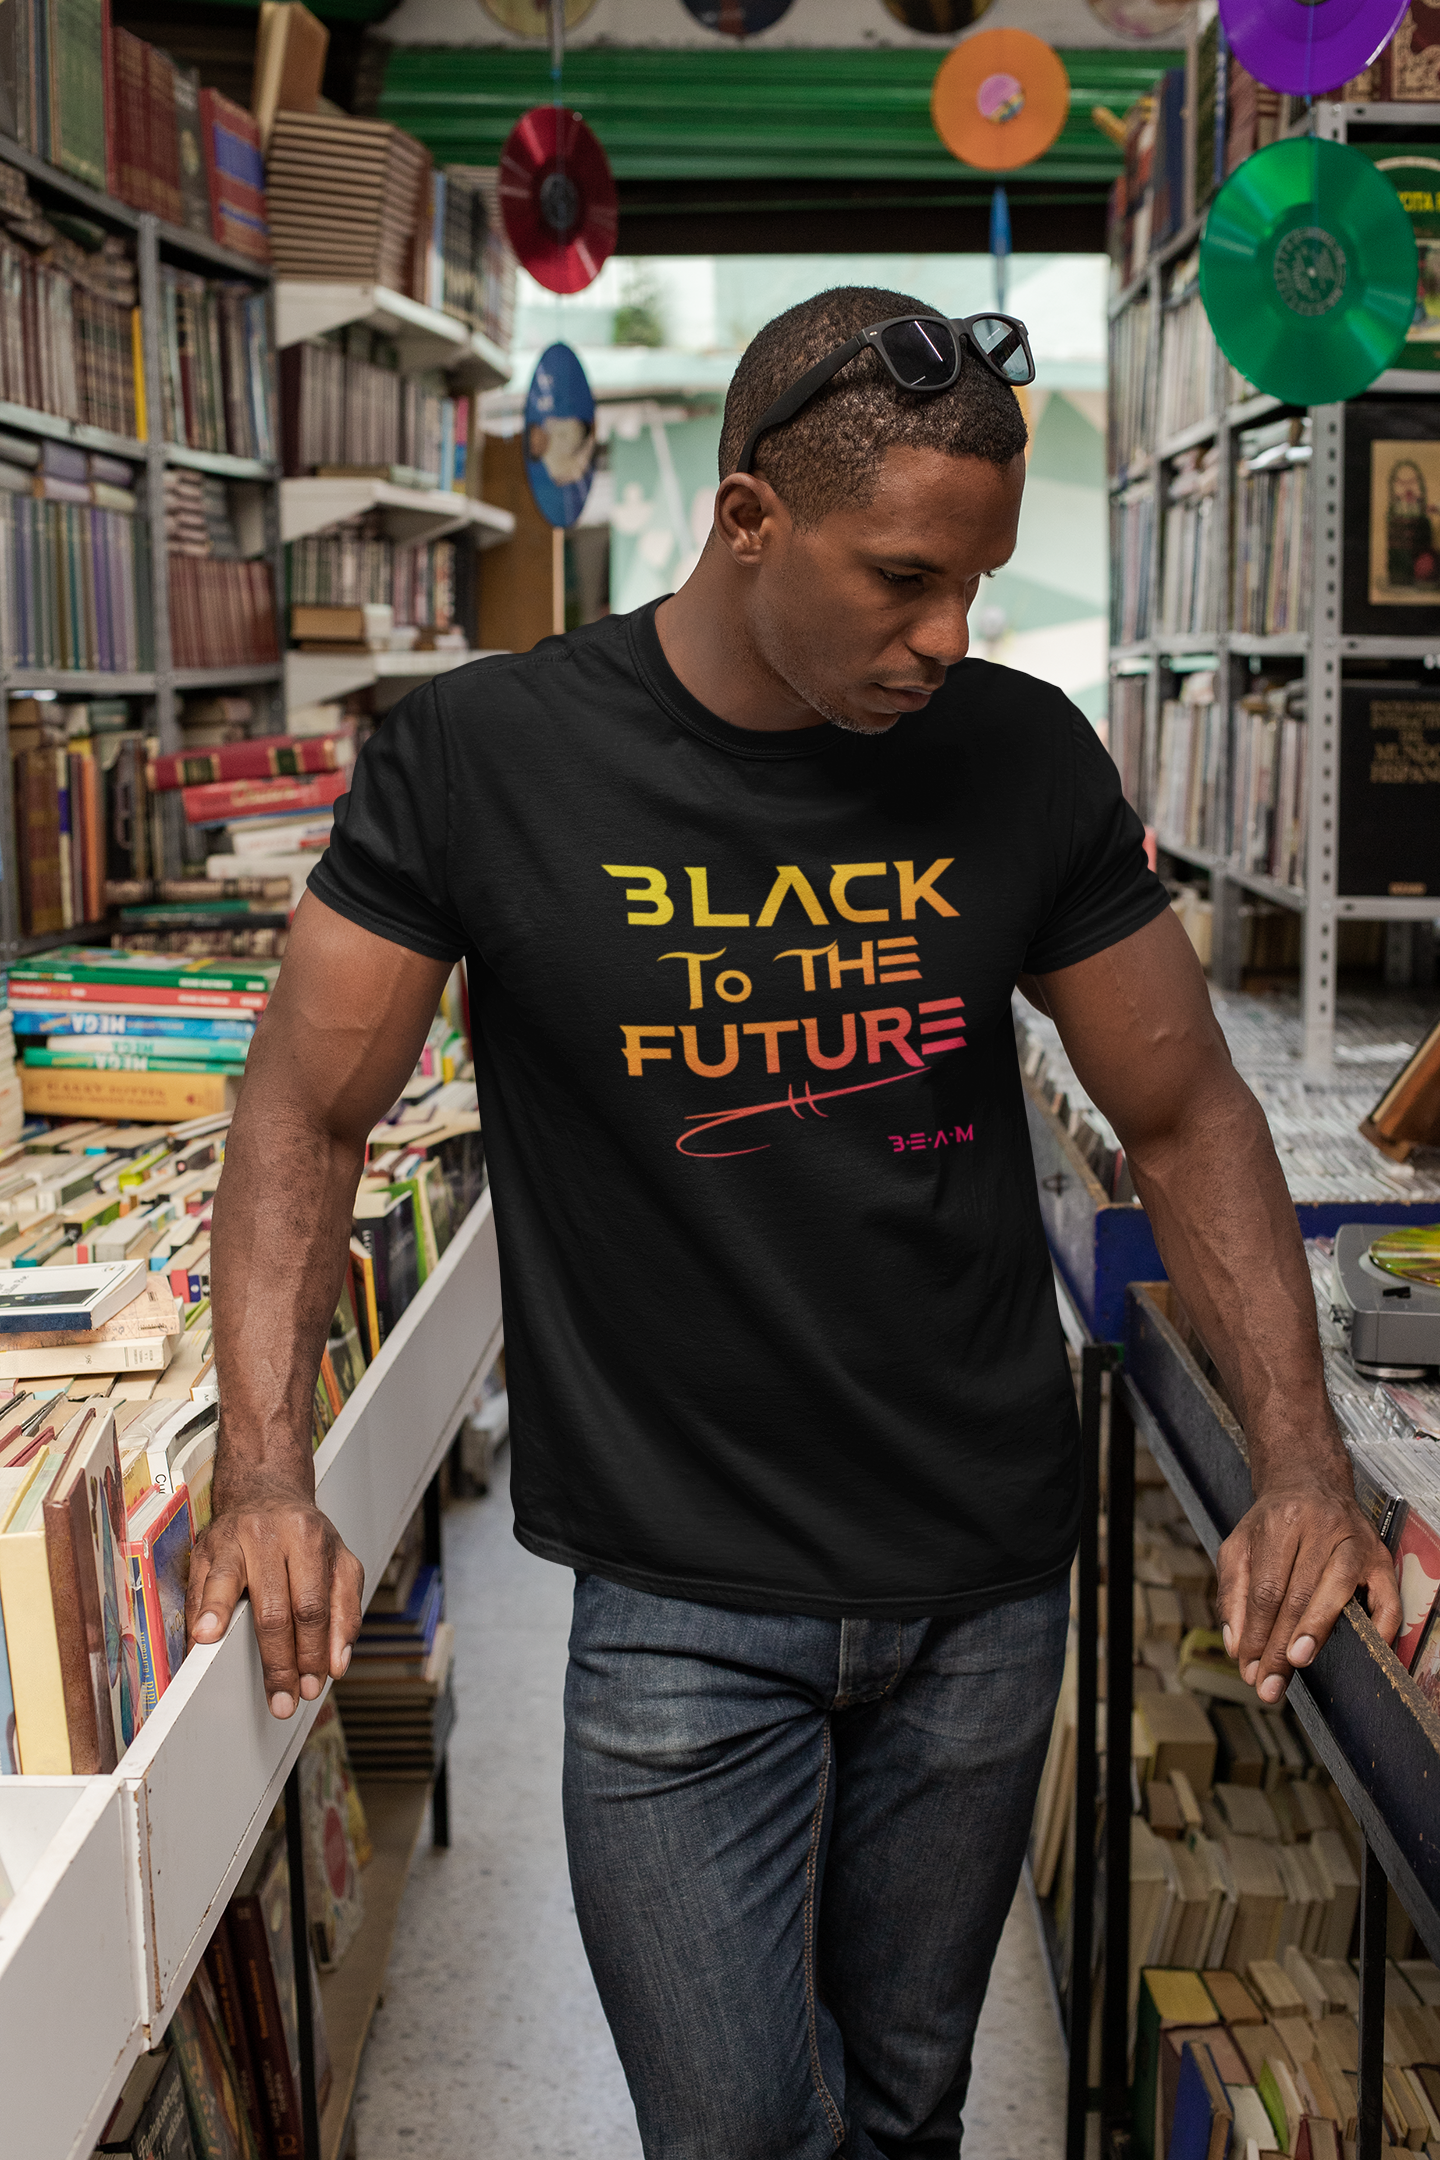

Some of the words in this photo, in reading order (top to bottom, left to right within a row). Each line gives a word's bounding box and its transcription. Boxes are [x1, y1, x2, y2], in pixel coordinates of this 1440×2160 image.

[601, 857, 961, 928] BLACK
[772, 935, 923, 992] THE
[71, 1012, 127, 1034] MEGA
[619, 996, 968, 1078] FUTURE
[95, 1054, 149, 1071] MEGA
